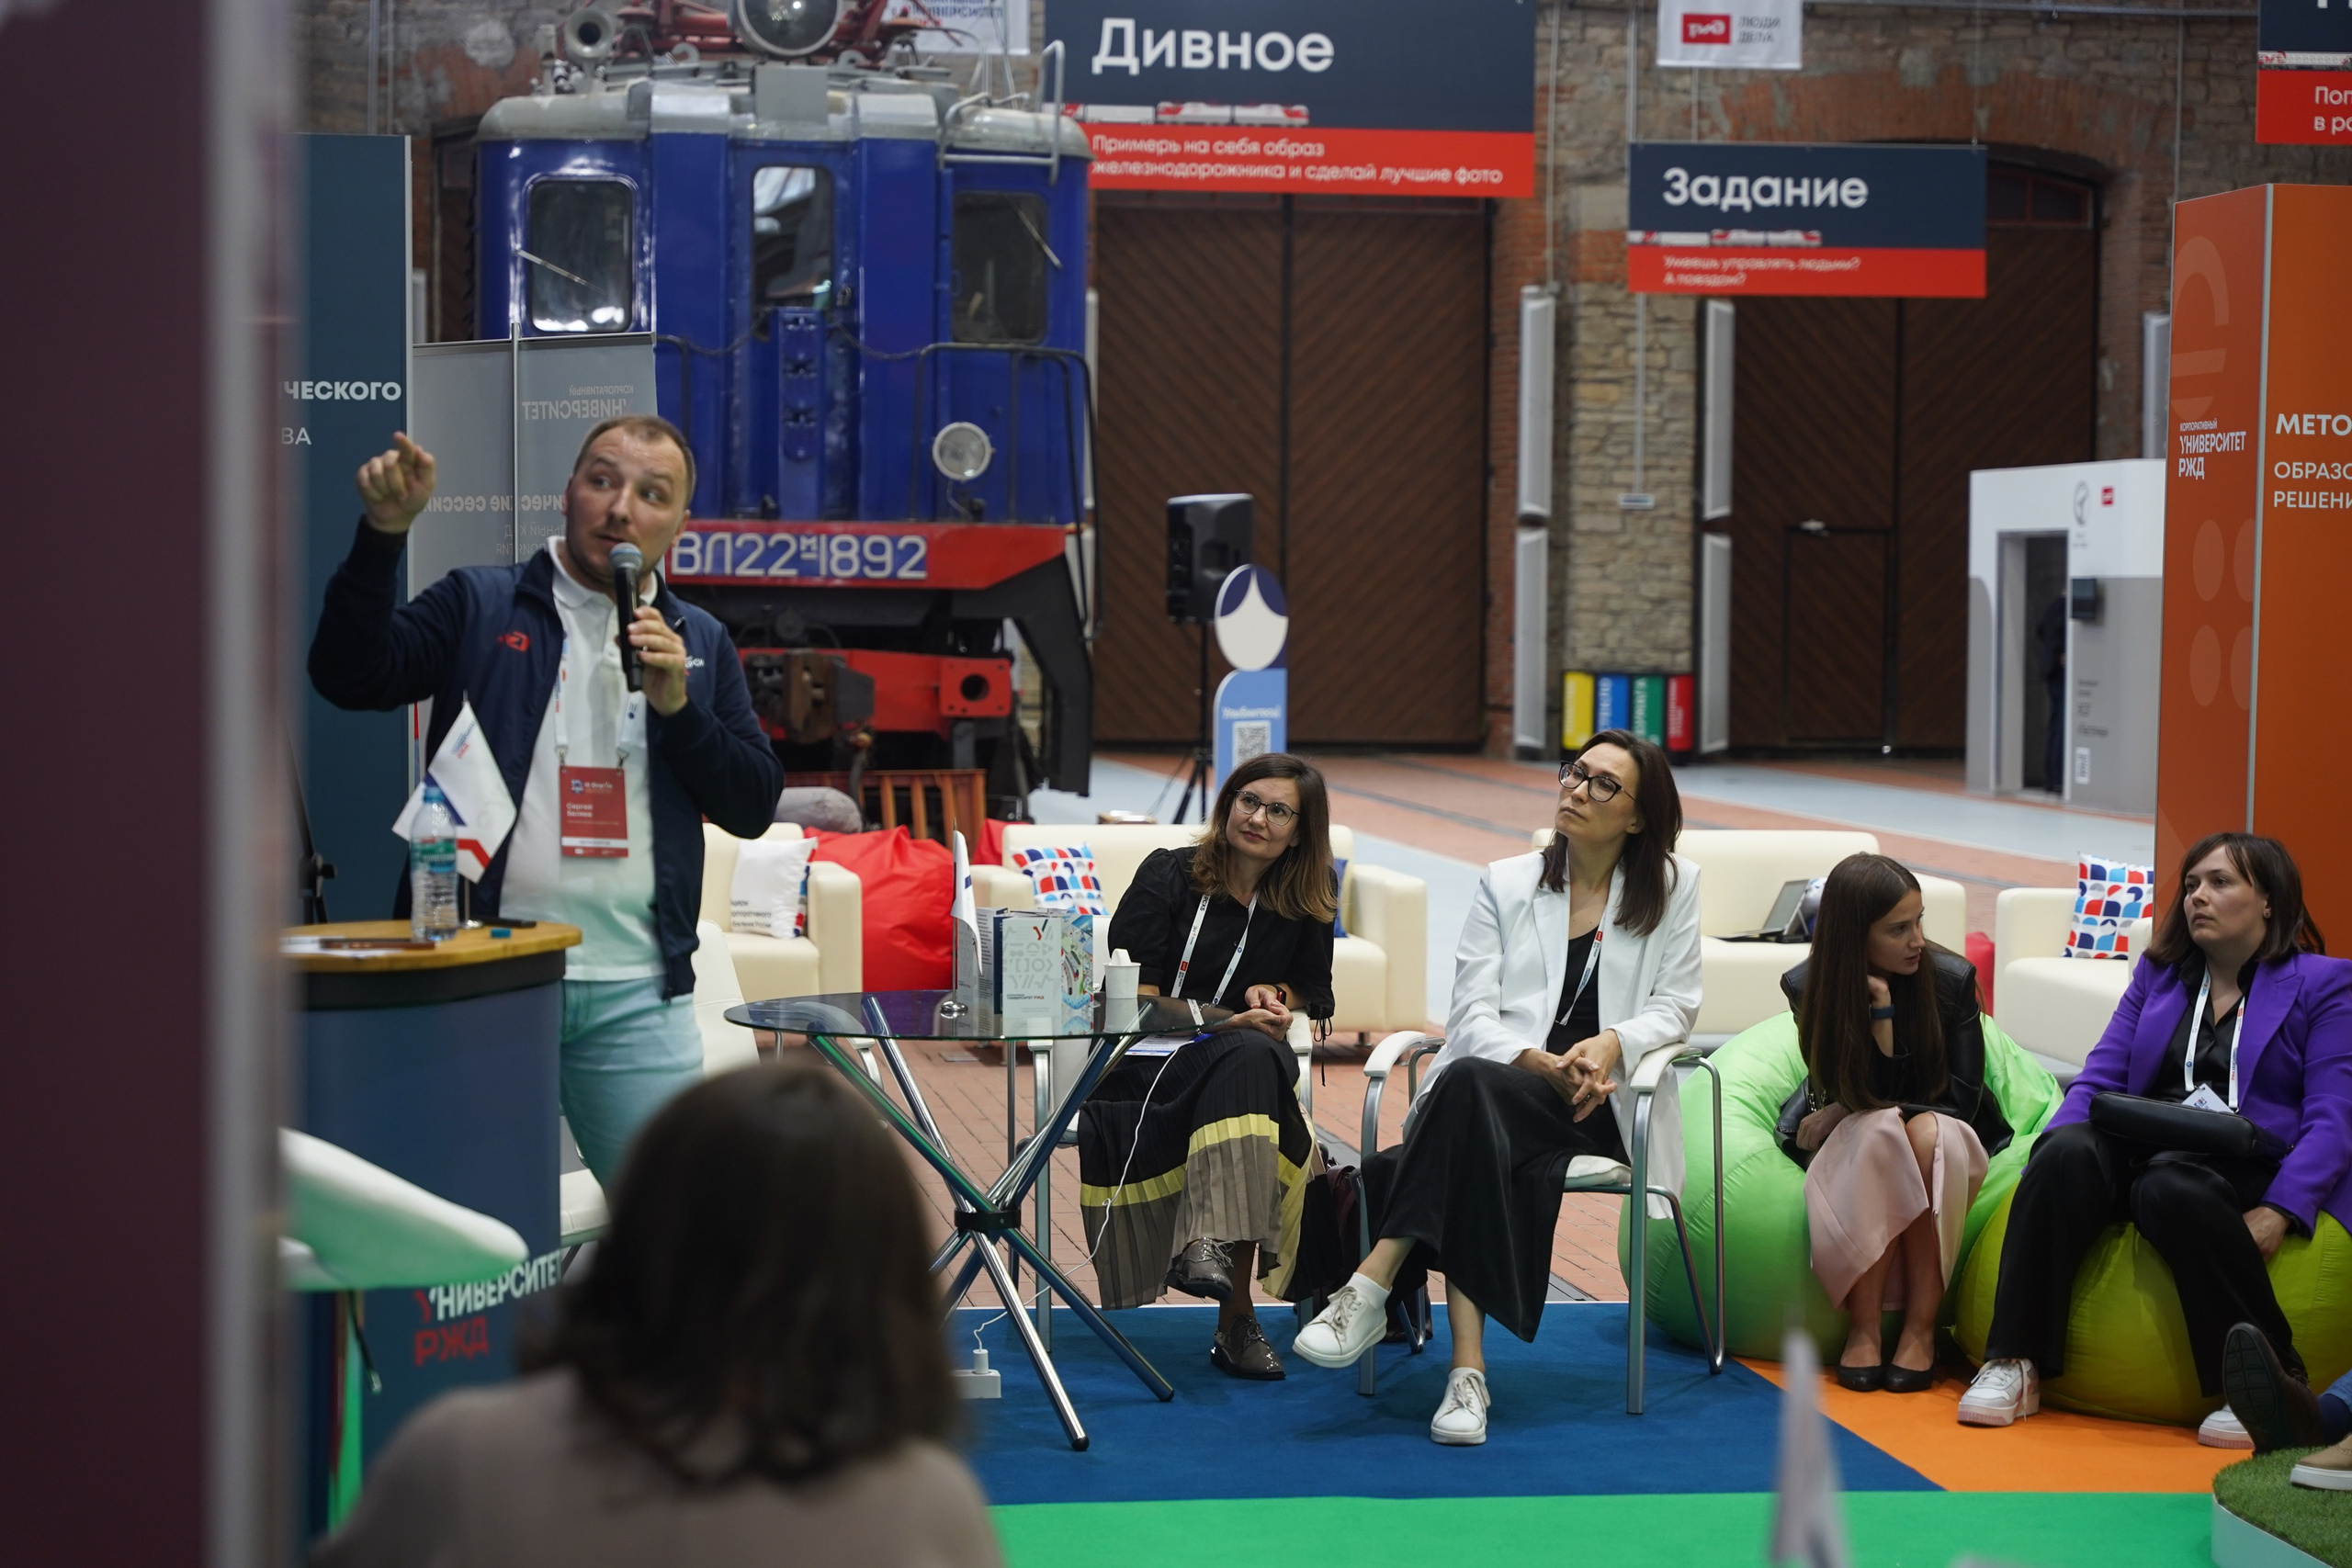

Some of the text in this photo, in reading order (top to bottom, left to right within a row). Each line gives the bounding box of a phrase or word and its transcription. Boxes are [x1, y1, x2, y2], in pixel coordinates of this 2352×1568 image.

[1091, 17, 1335, 75] Дивное
[1092, 135, 1325, 159] Примерь на себя образ
[1091, 161, 1503, 186] железнодорожника и сделай лучшие фото
[1662, 166, 1870, 212] Задание
[1664, 271, 1675, 285] А
[2180, 417, 2218, 432] КОРПОРАТИВНЫЙ
[2179, 431, 2247, 455] УНИВЕРСИТЕТ
[2178, 457, 2205, 480] РЖД
[414, 1315, 490, 1366] РЖД
